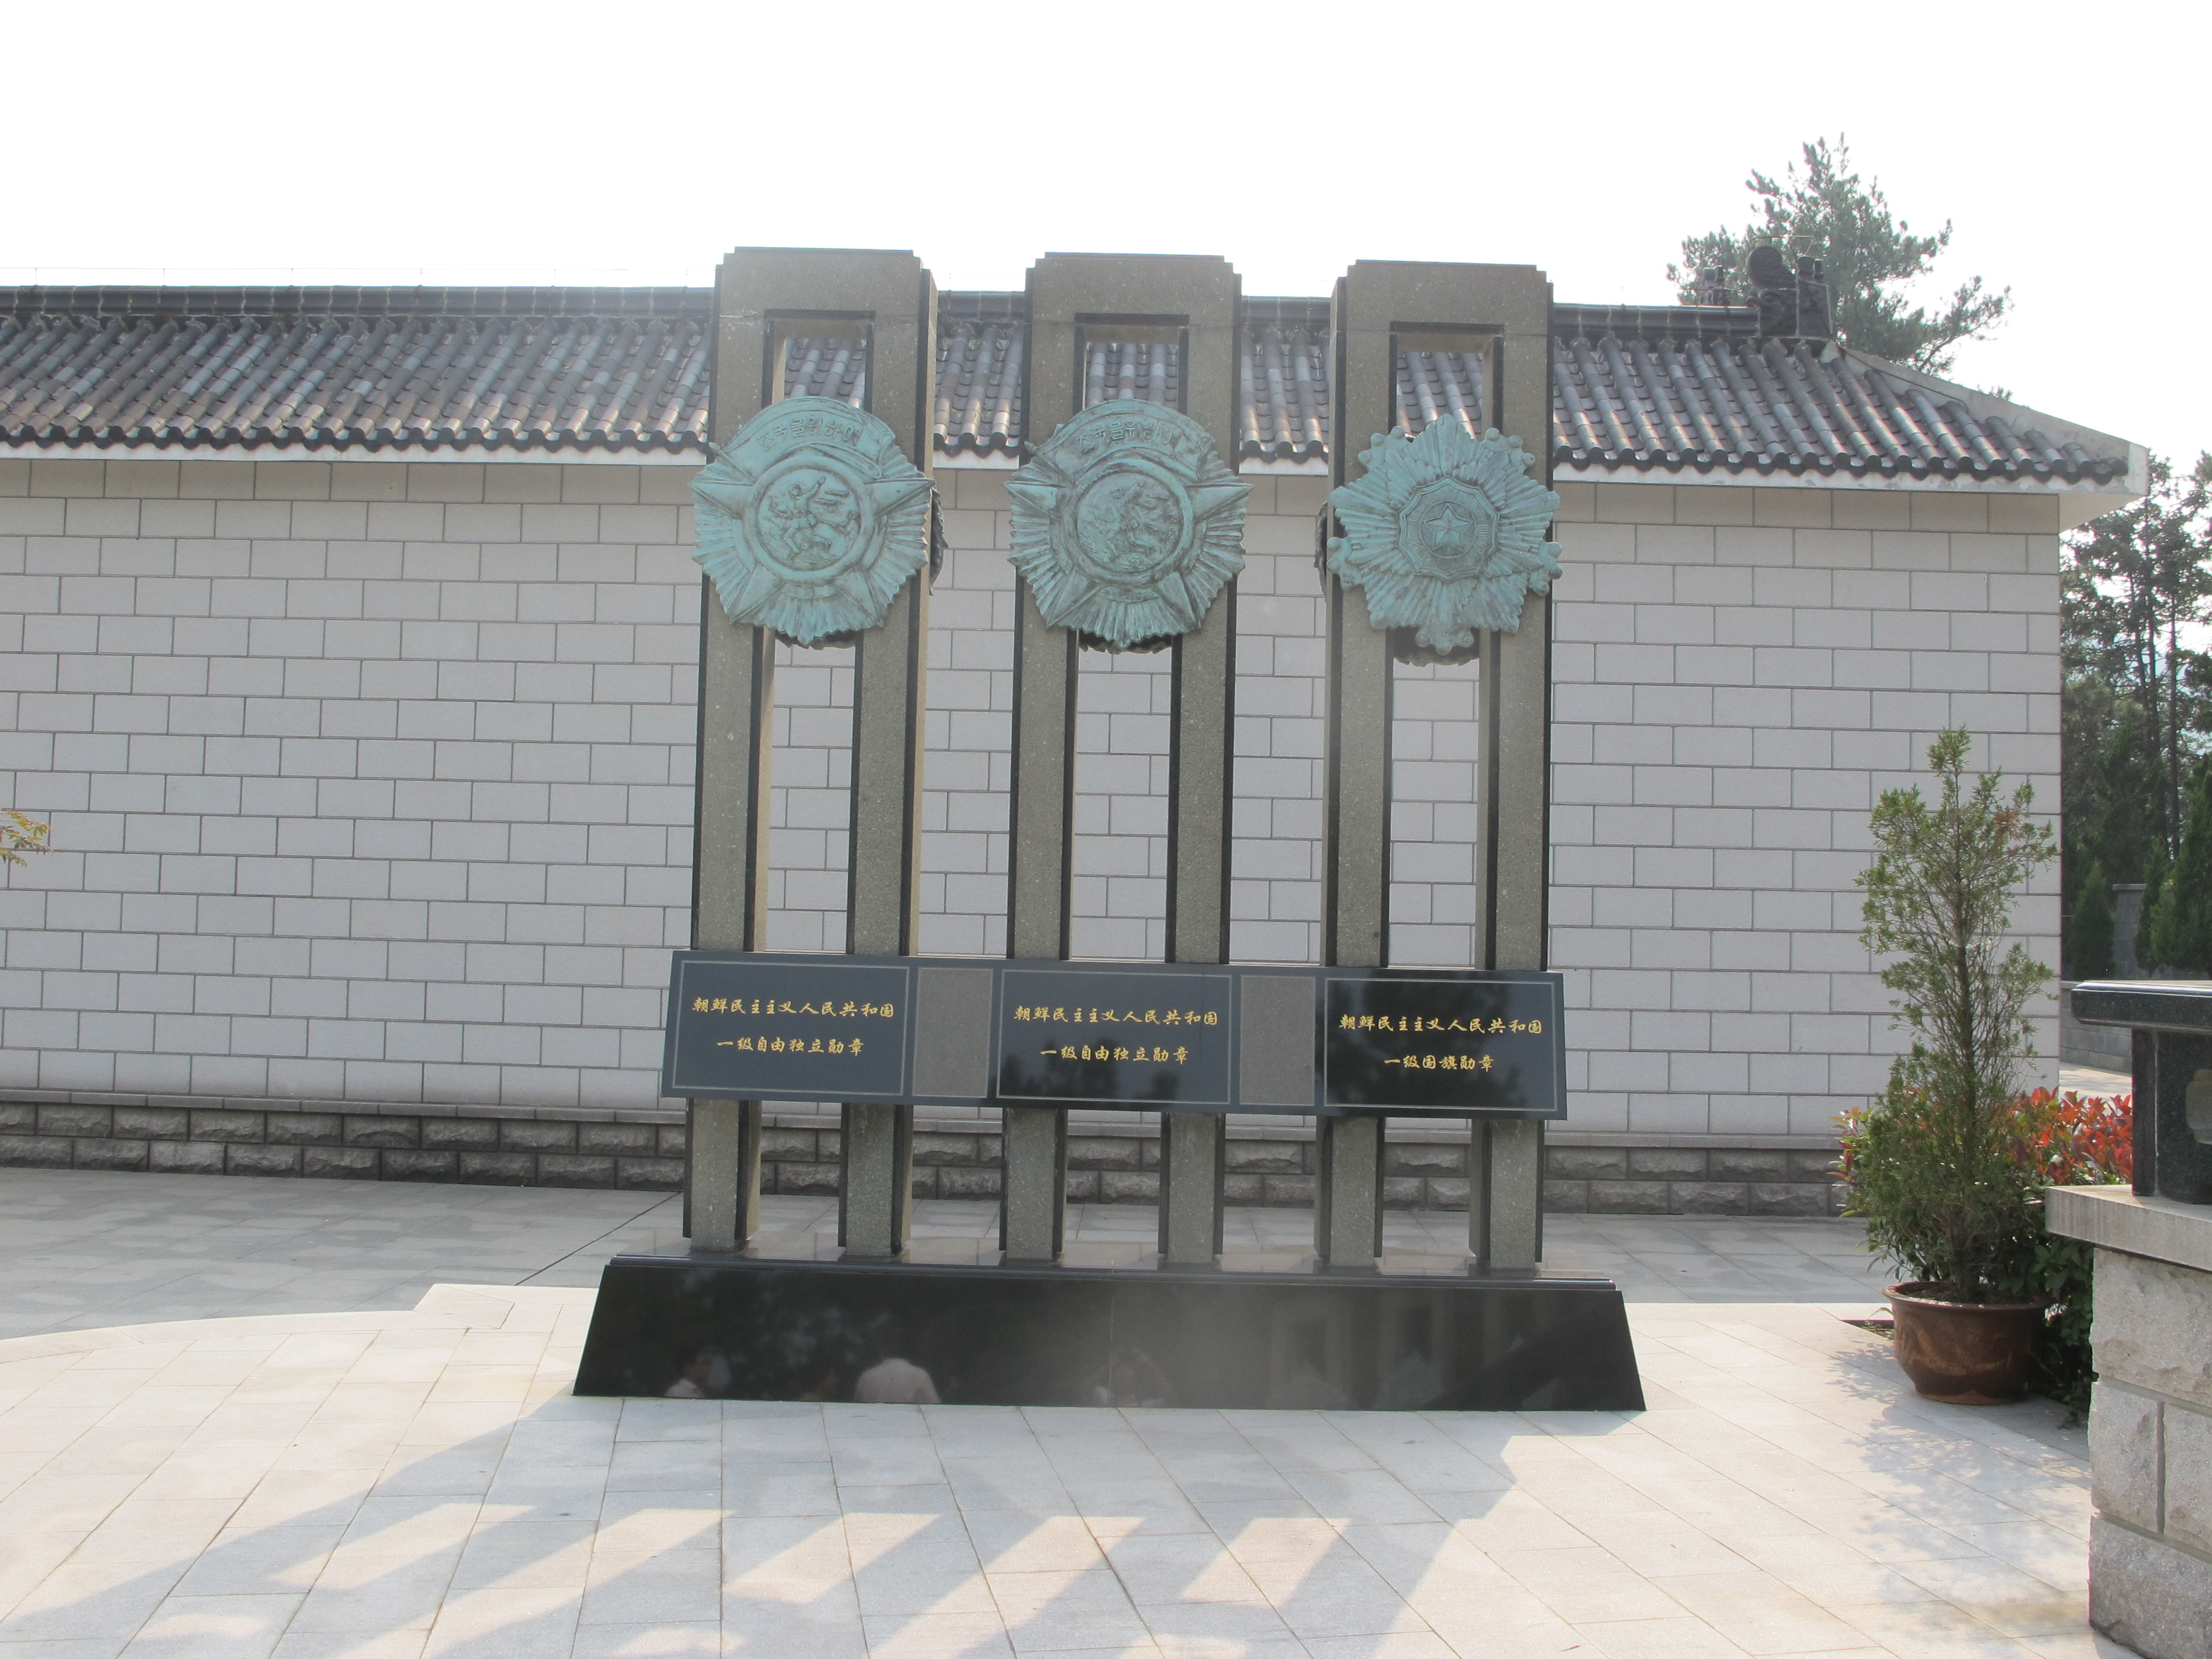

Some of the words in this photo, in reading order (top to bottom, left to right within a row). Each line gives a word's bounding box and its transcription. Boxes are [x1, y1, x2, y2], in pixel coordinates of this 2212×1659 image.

[692, 996, 895, 1019] 朝鲜民主主义人民共和国
[1013, 1004, 1219, 1027] 朝鲜民主主义人民共和国
[1338, 1013, 1544, 1035] 朝鲜民主主义人民共和国
[716, 1036, 865, 1057] 一级自由独立勋章
[1039, 1044, 1190, 1065] 一级自由独立勋章
[1383, 1054, 1495, 1073] 一级国旗勋章
